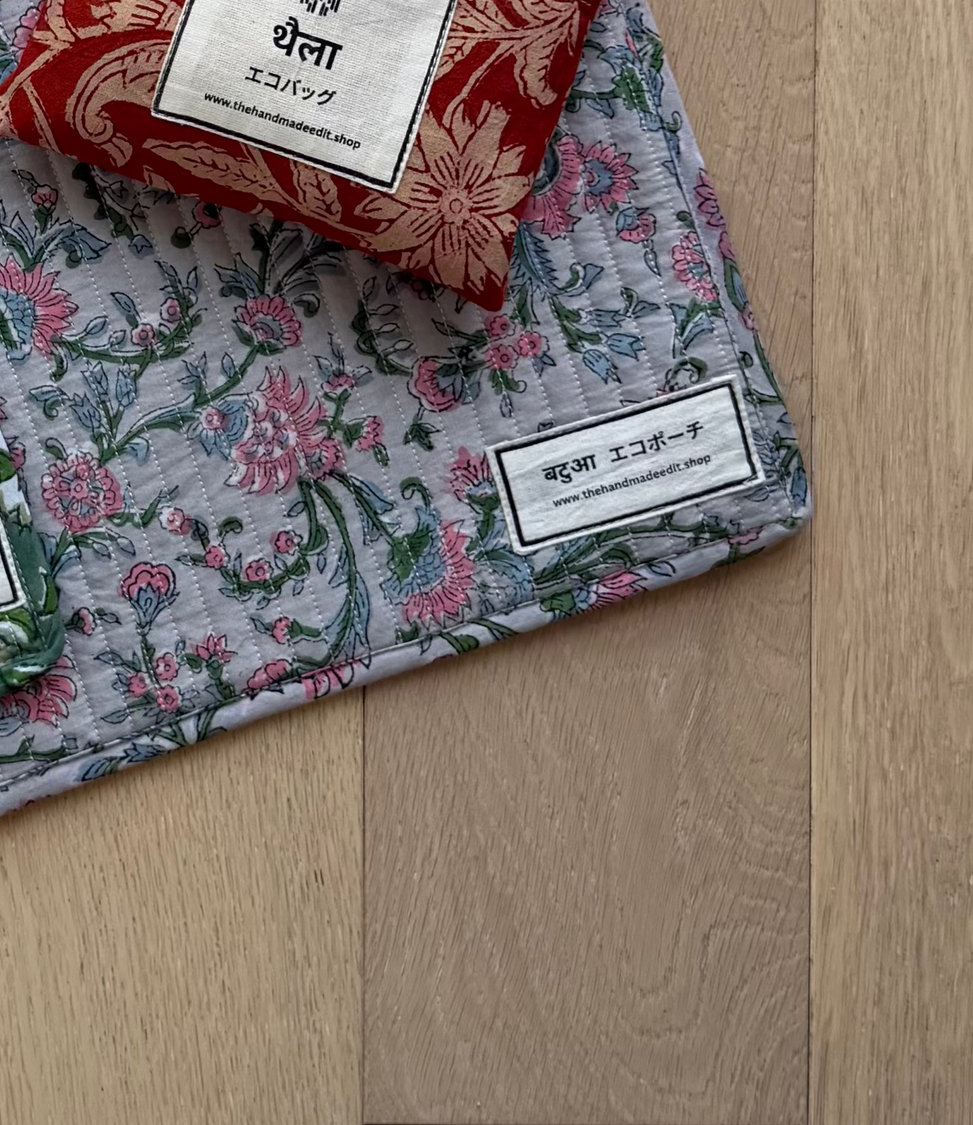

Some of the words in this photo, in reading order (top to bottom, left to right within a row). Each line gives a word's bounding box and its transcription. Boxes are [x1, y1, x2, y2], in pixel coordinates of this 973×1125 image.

[273, 16, 343, 70] थैला
[244, 66, 337, 105] エコバッグ
[204, 91, 361, 149] www.thehandmadeedit.shop
[542, 454, 597, 483] बटुआ
[609, 421, 704, 463] エコポーチ
[552, 453, 711, 507] www.thehandmadeedit.shop
